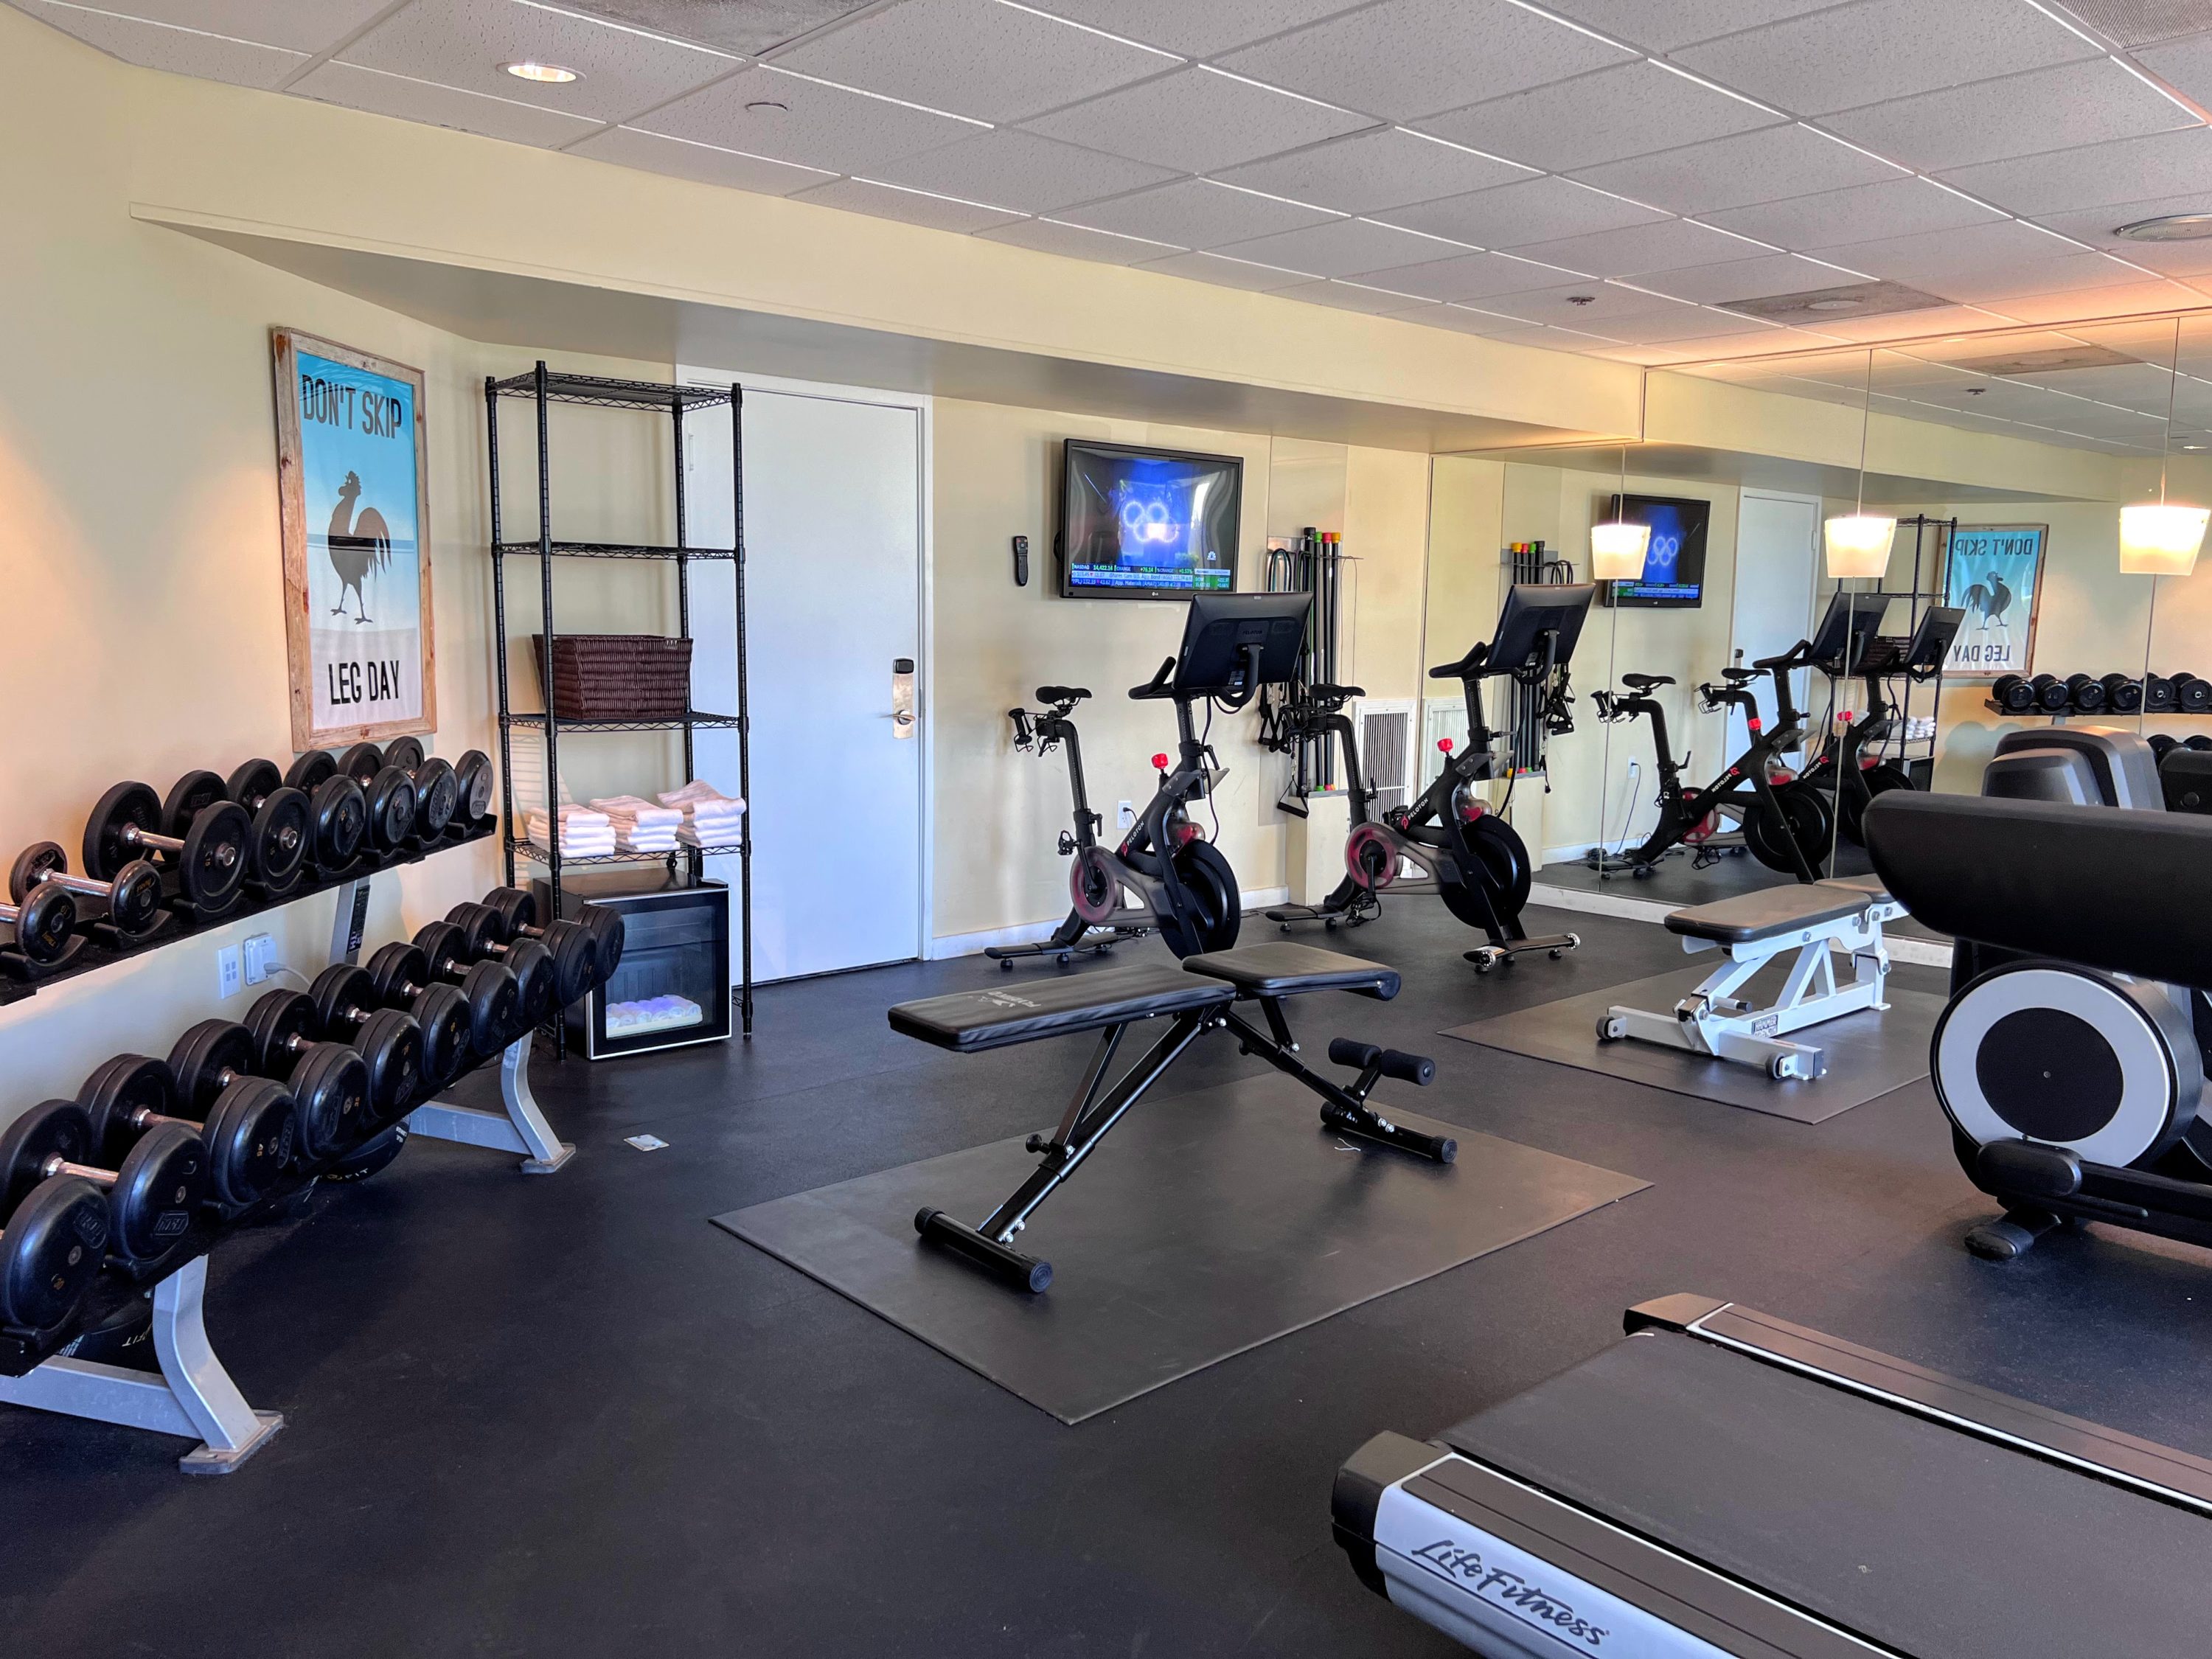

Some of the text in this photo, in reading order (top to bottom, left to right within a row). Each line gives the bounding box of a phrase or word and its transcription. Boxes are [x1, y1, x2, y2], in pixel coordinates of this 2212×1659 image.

[302, 373, 402, 439] DON'T SKIP
[329, 659, 400, 705] LEG DAY
[1408, 798, 1429, 821] PELOTON
[1127, 820, 1144, 846] PELOTON
[1411, 1540, 1606, 1646] Life Fitness
